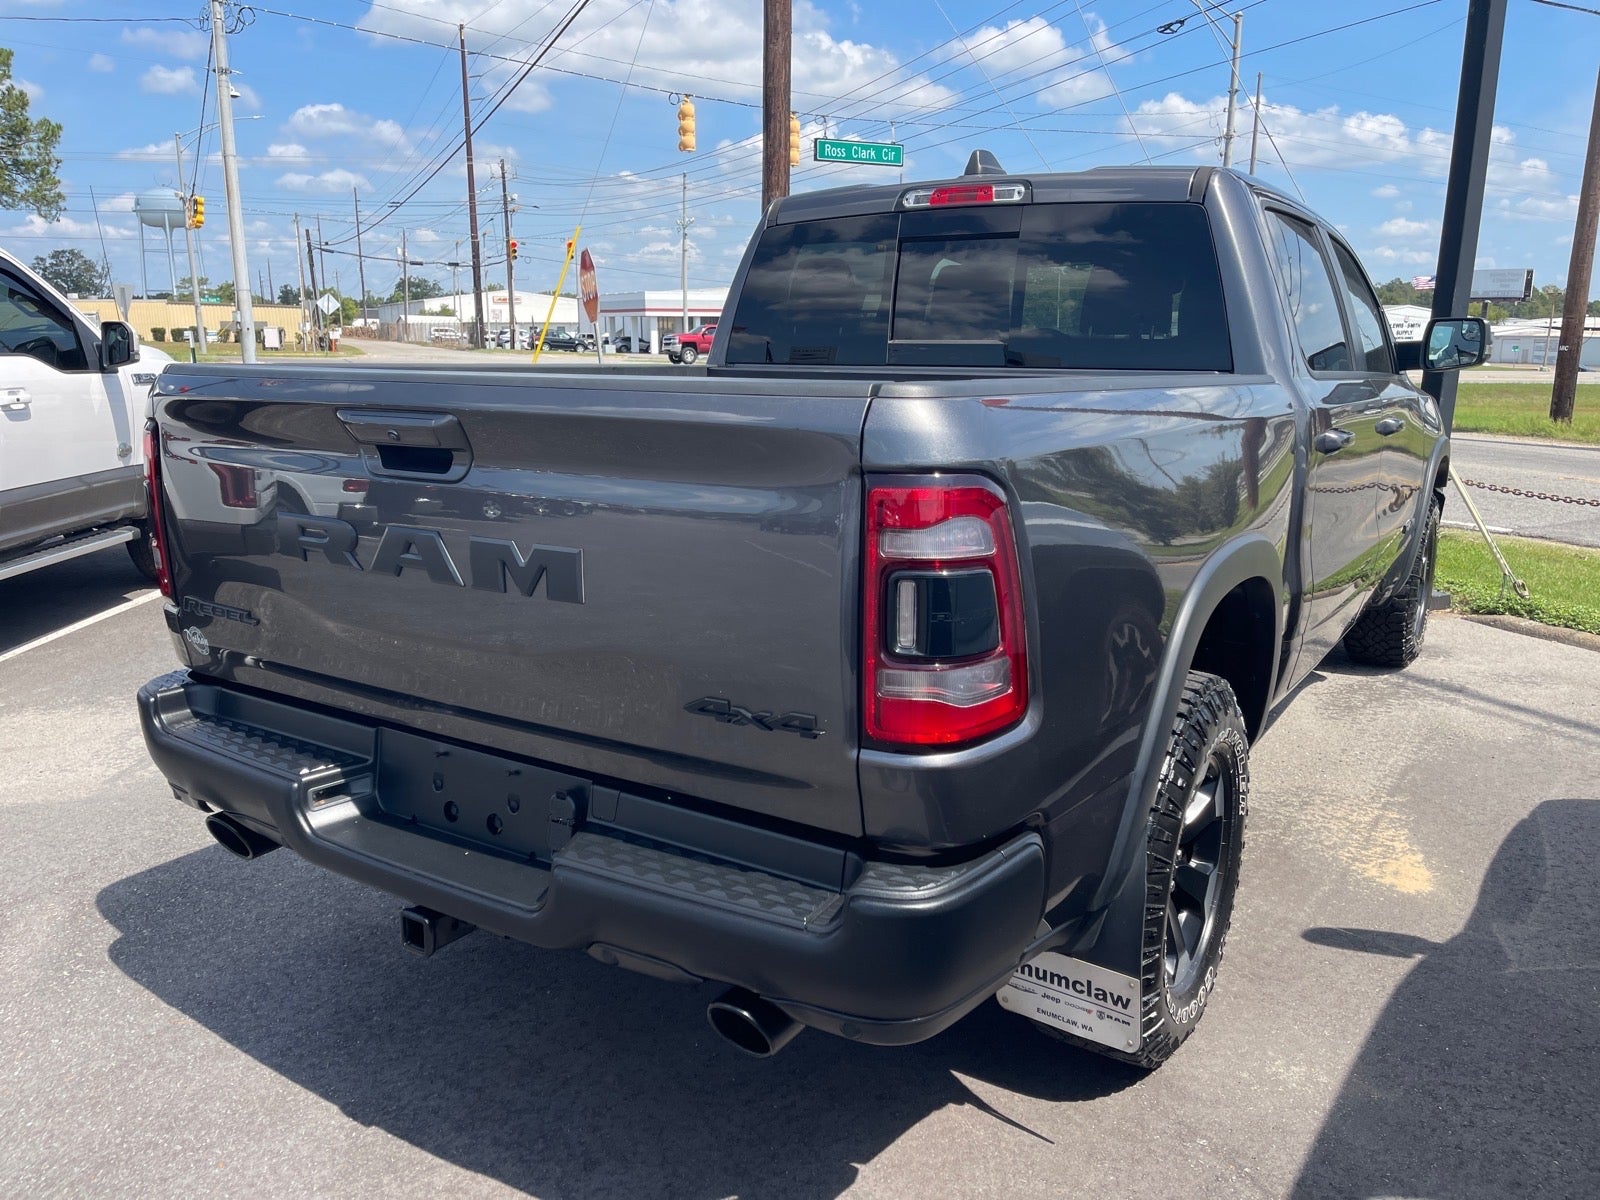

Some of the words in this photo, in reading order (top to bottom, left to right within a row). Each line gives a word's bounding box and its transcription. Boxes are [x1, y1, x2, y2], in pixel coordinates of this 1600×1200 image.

[824, 144, 846, 157] Ross
[852, 146, 876, 159] Clark
[882, 149, 895, 161] Cir
[581, 269, 597, 303] STOP
[276, 511, 586, 604] RAM
[183, 595, 260, 627] REBEL
[1036, 1007, 1080, 1028] ENUMCLAW,
[1081, 1023, 1094, 1032] WA
[1041, 992, 1061, 1004] Jeep
[1106, 1014, 1131, 1027] RAM
